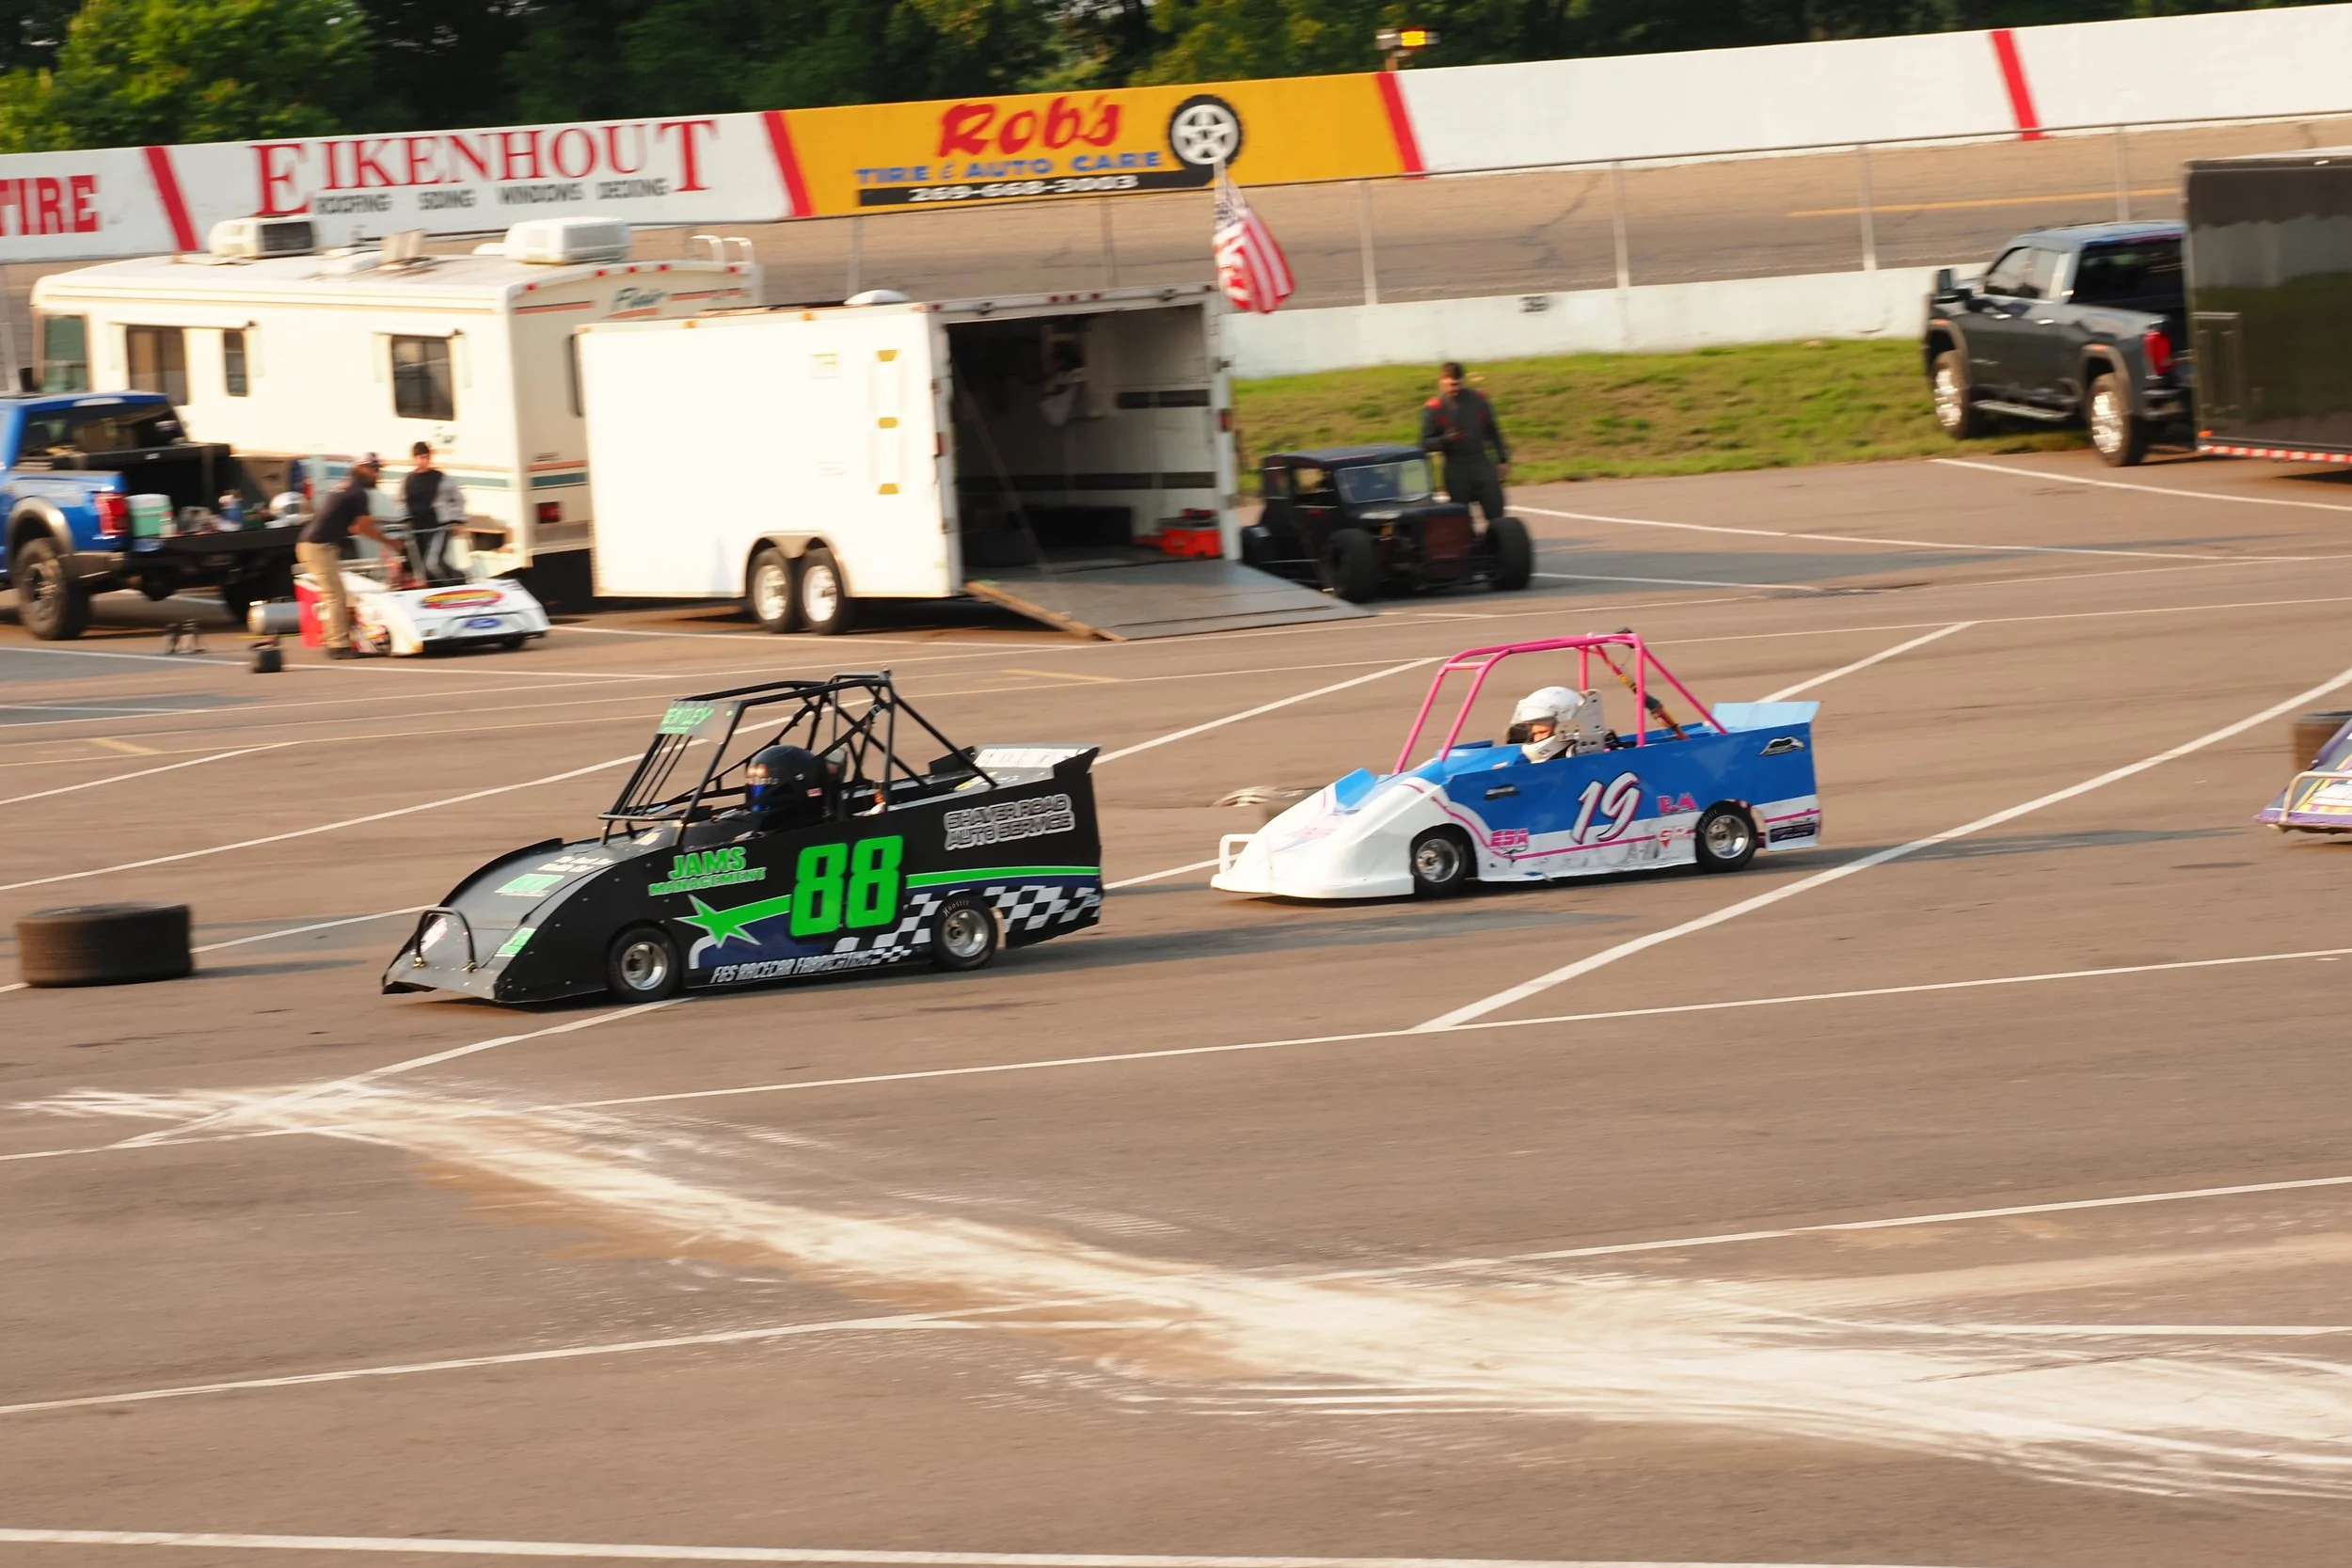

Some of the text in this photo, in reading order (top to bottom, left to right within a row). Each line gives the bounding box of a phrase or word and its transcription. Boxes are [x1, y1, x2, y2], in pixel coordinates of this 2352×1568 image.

[248, 119, 719, 216] EIKENHOUT
[855, 166, 931, 184] TIRE
[963, 158, 1054, 179] AUTO
[1071, 151, 1164, 172] CARE
[498, 182, 585, 205] WINDOWS
[1017, 793, 1072, 819] ROAD
[1569, 771, 1643, 845] 19
[945, 810, 1075, 850] AUTO SERVICE
[667, 846, 747, 880] JAMS
[647, 866, 768, 896] MANAGEMENT
[790, 834, 904, 937] 88
[736, 958, 796, 981] RACECAR
